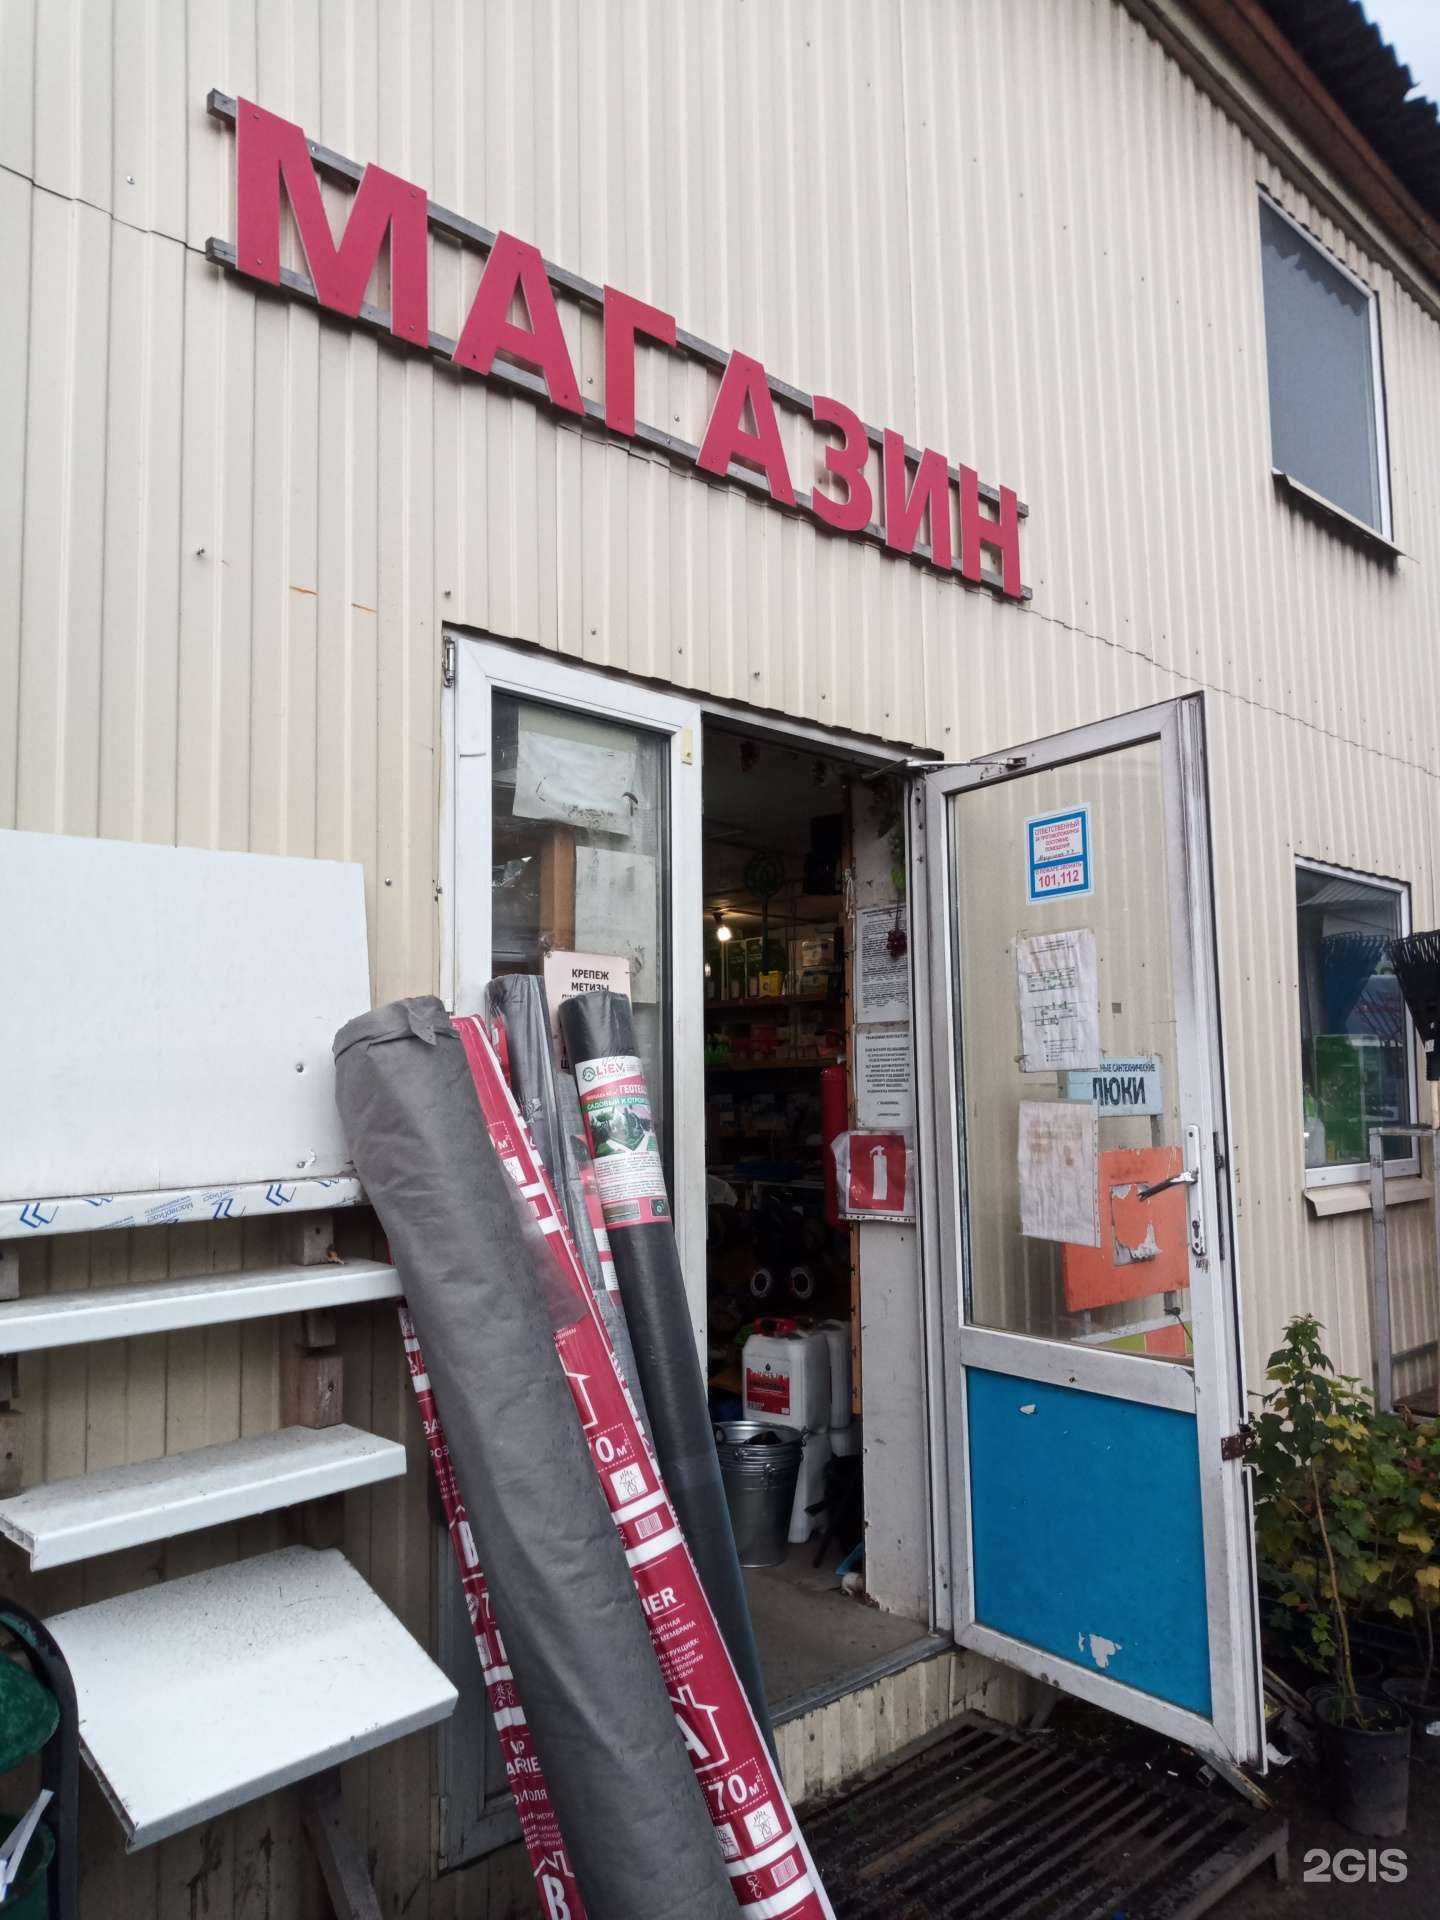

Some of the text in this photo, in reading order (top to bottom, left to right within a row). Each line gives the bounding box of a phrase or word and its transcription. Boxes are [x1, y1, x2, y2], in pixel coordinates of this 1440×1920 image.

[236, 96, 1022, 600] МАГАЗИН
[1039, 869, 1080, 888] 101,112
[571, 968, 610, 981] КРЕПЕЖ
[571, 982, 610, 993] МЕТИЗЫ
